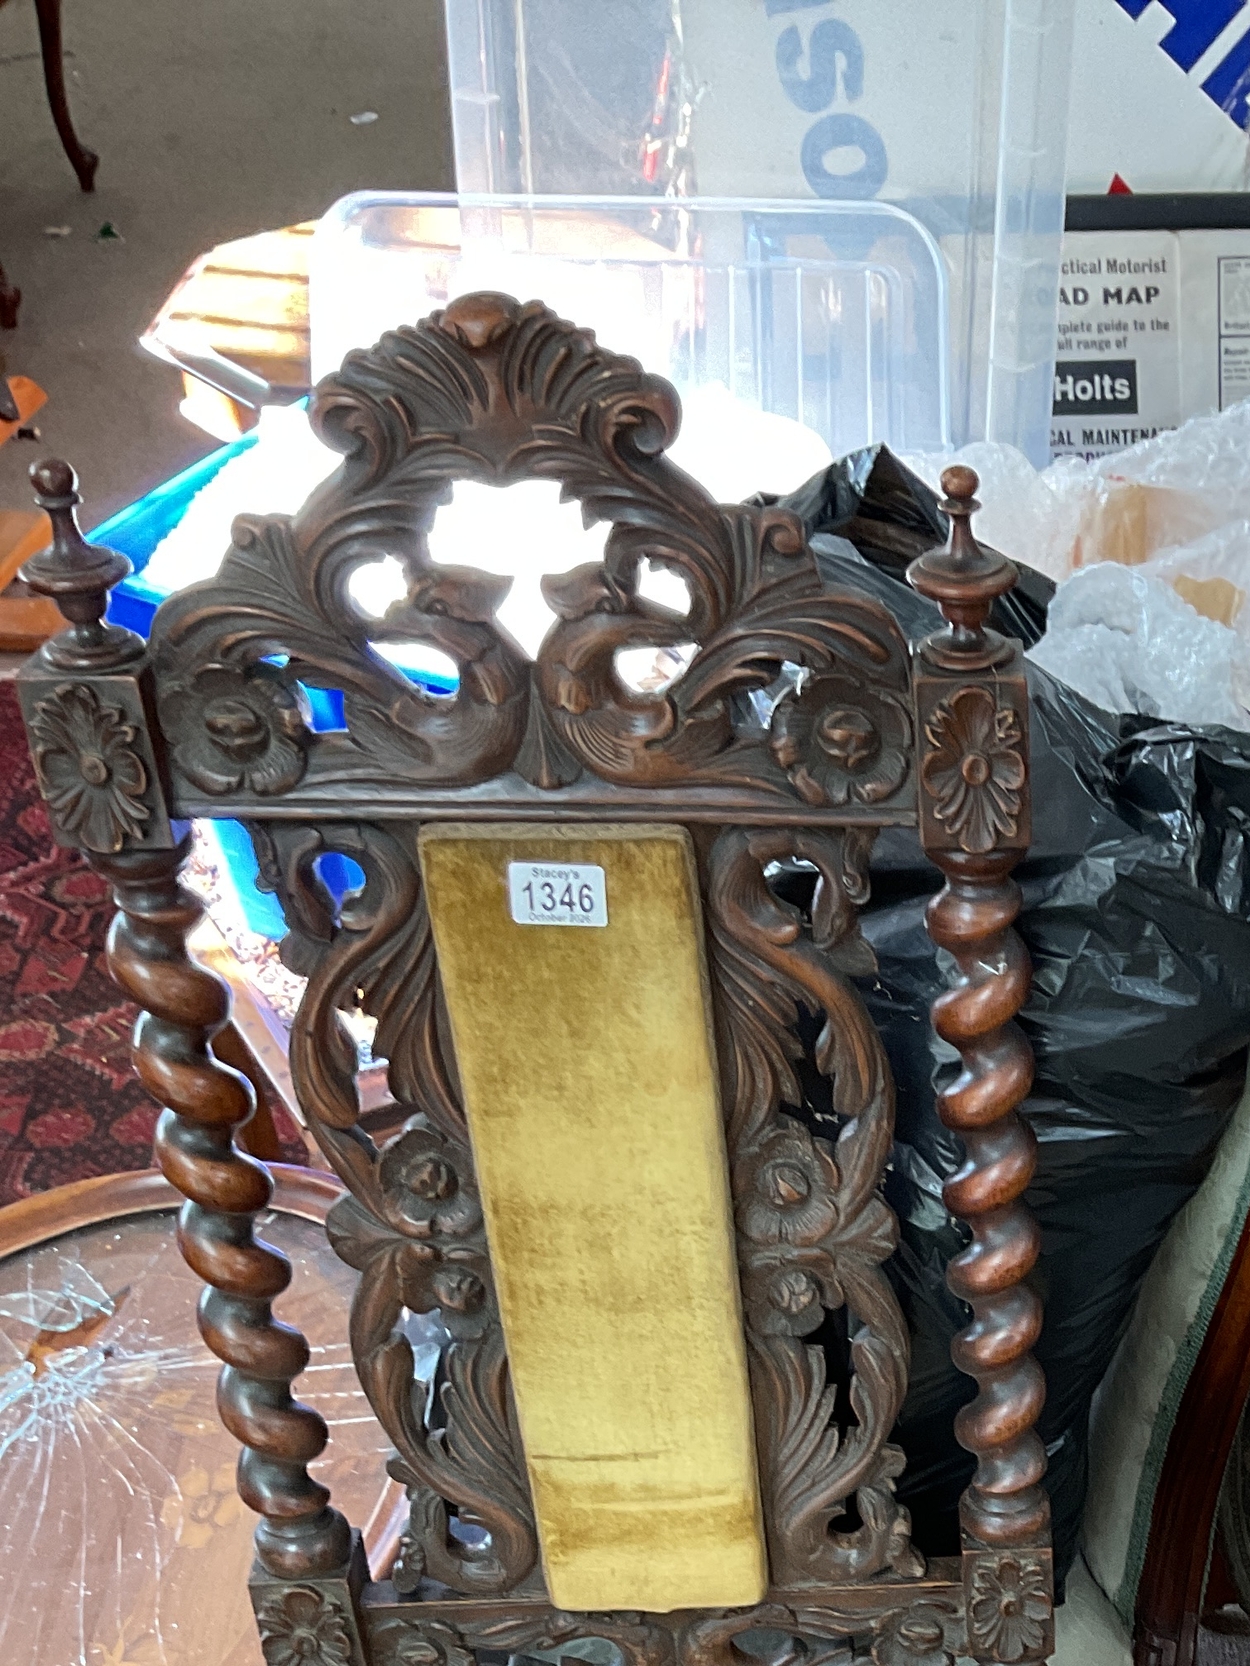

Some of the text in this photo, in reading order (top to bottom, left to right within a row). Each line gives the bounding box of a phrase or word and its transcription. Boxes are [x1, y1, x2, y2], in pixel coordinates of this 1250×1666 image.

[1061, 257, 1167, 275] ctical Motorist
[1059, 286, 1160, 306] AD MAP
[1058, 318, 1170, 335] plete guide to the
[1057, 336, 1128, 352] ull range of
[1054, 373, 1131, 401] Holts
[531, 867, 580, 880] Stacey's
[522, 881, 594, 913] 1346
[528, 912, 567, 923] October
